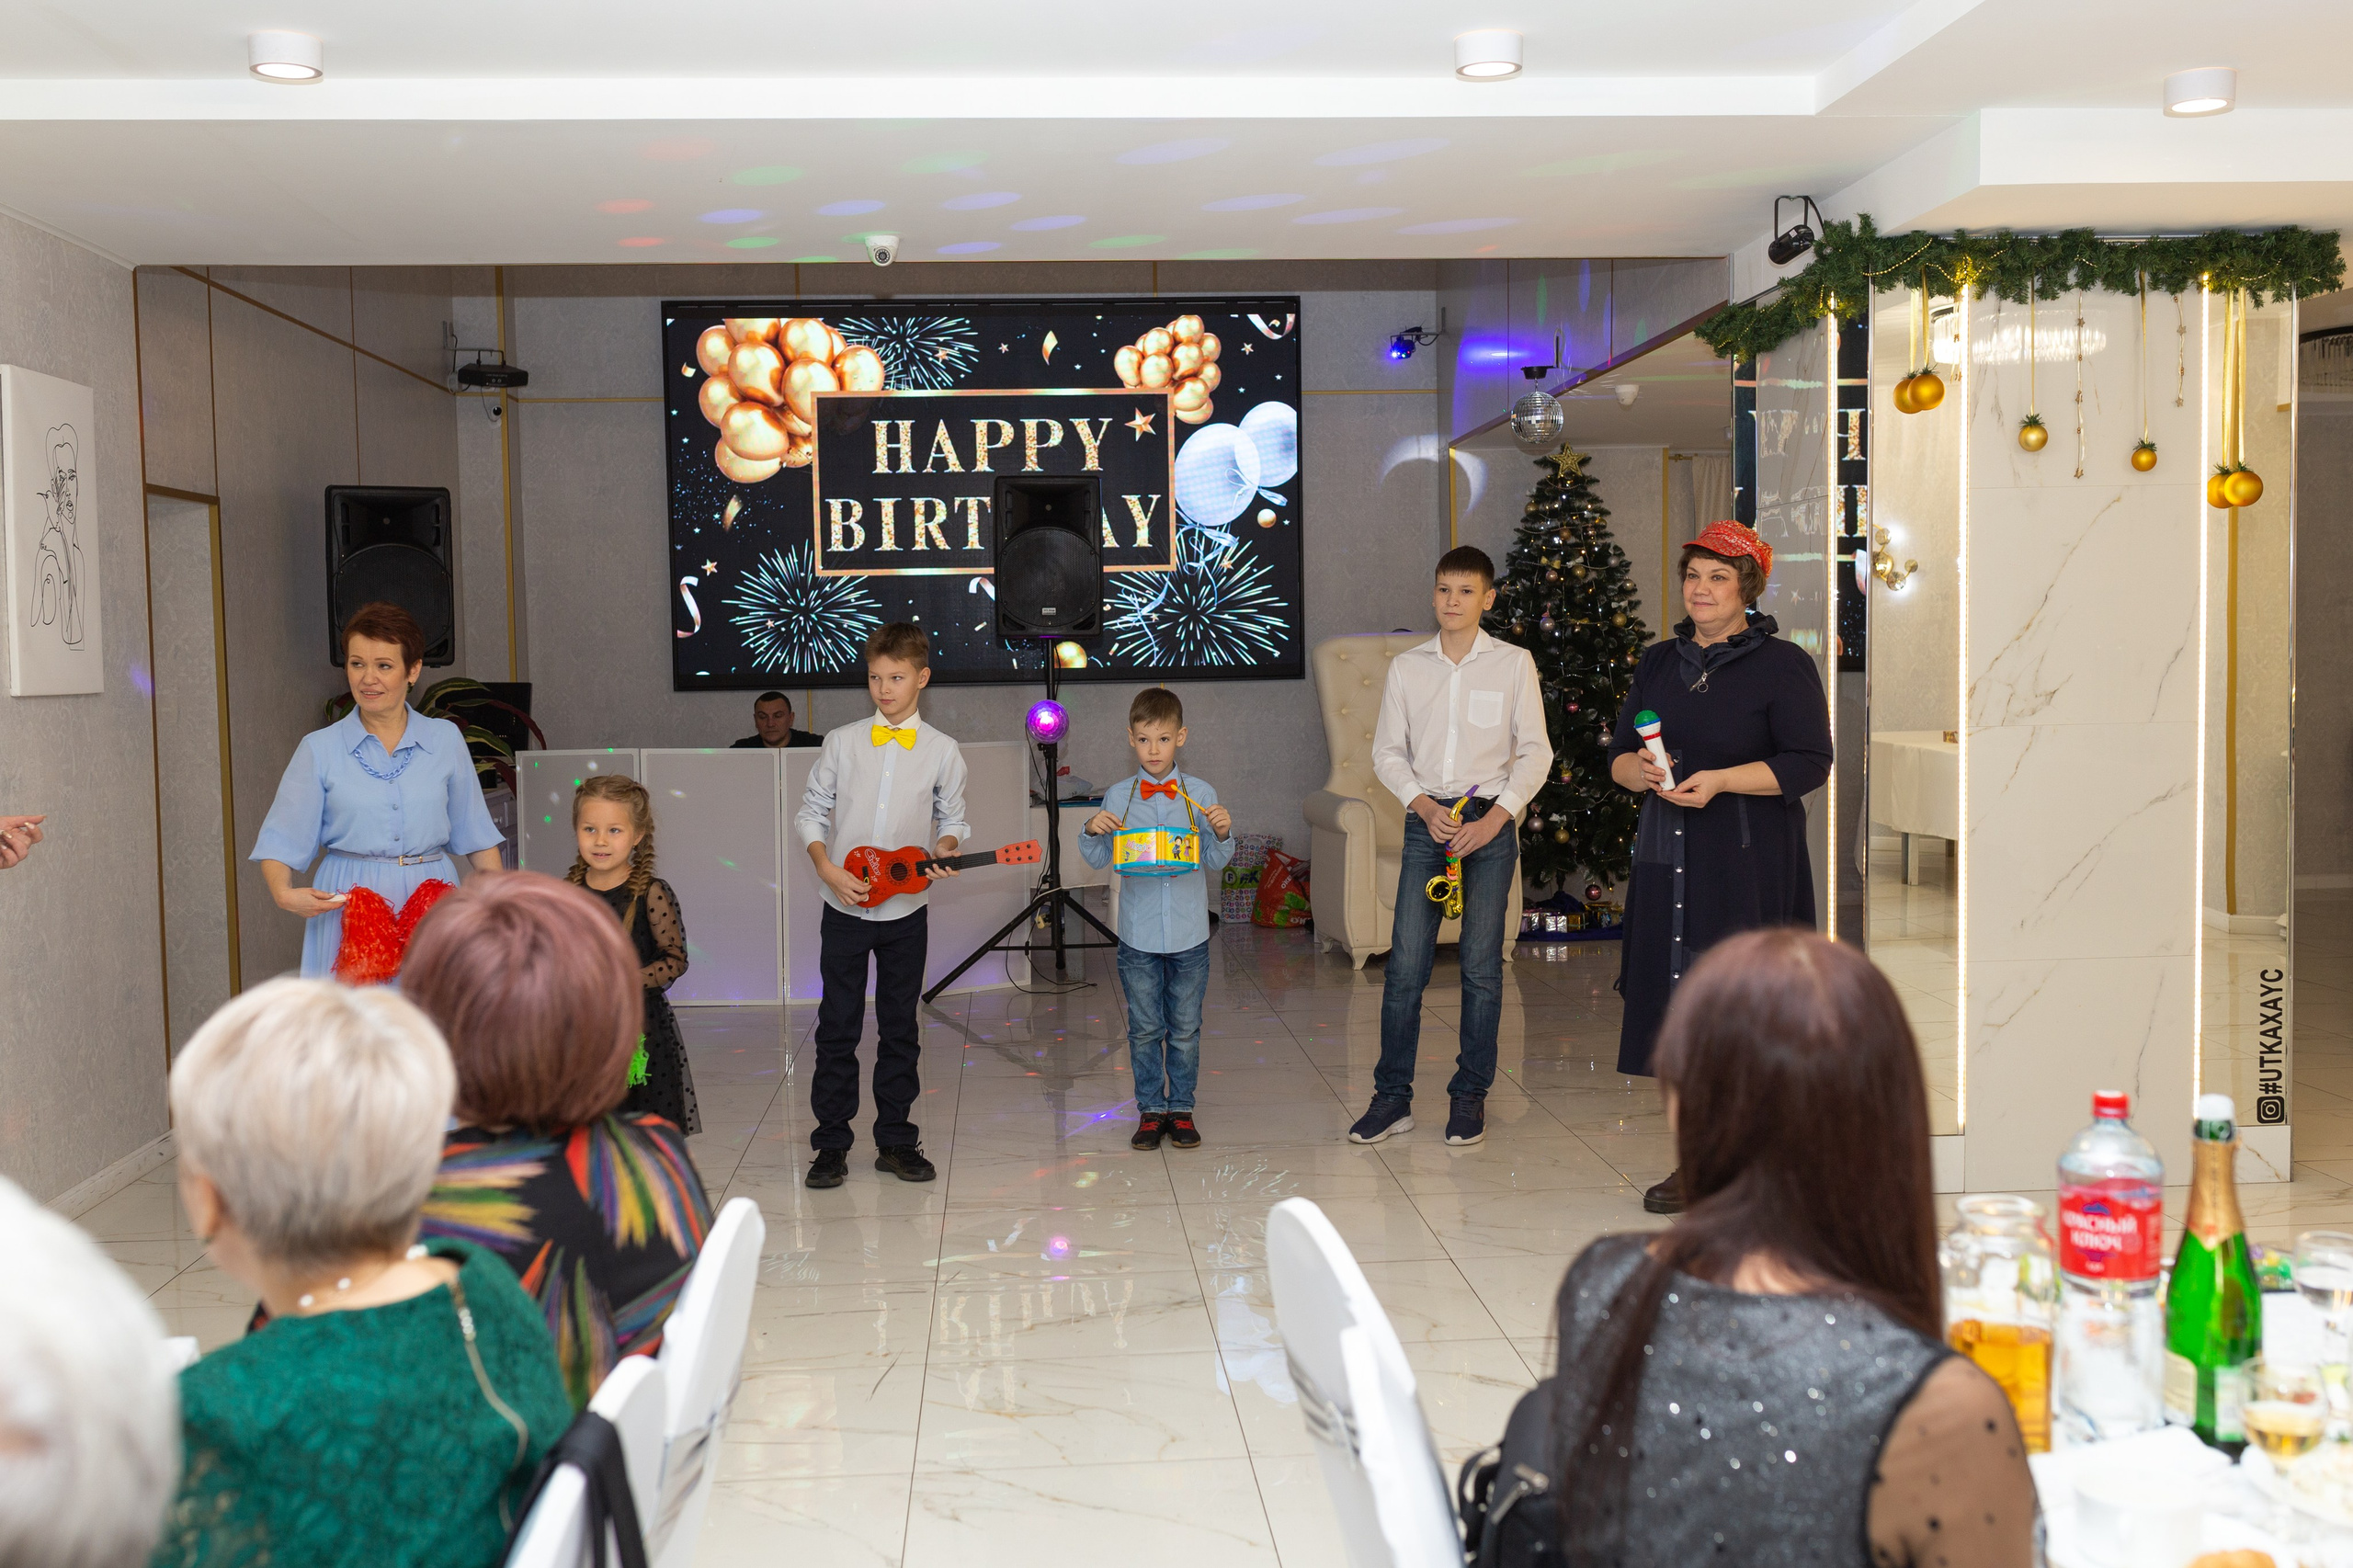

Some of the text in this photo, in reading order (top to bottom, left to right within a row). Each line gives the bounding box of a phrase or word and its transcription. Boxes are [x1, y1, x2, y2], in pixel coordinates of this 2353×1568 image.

[871, 417, 1113, 473] HAPPY
[824, 494, 1162, 551] BIRTY
[2258, 968, 2284, 1095] #UTKAXAYC
